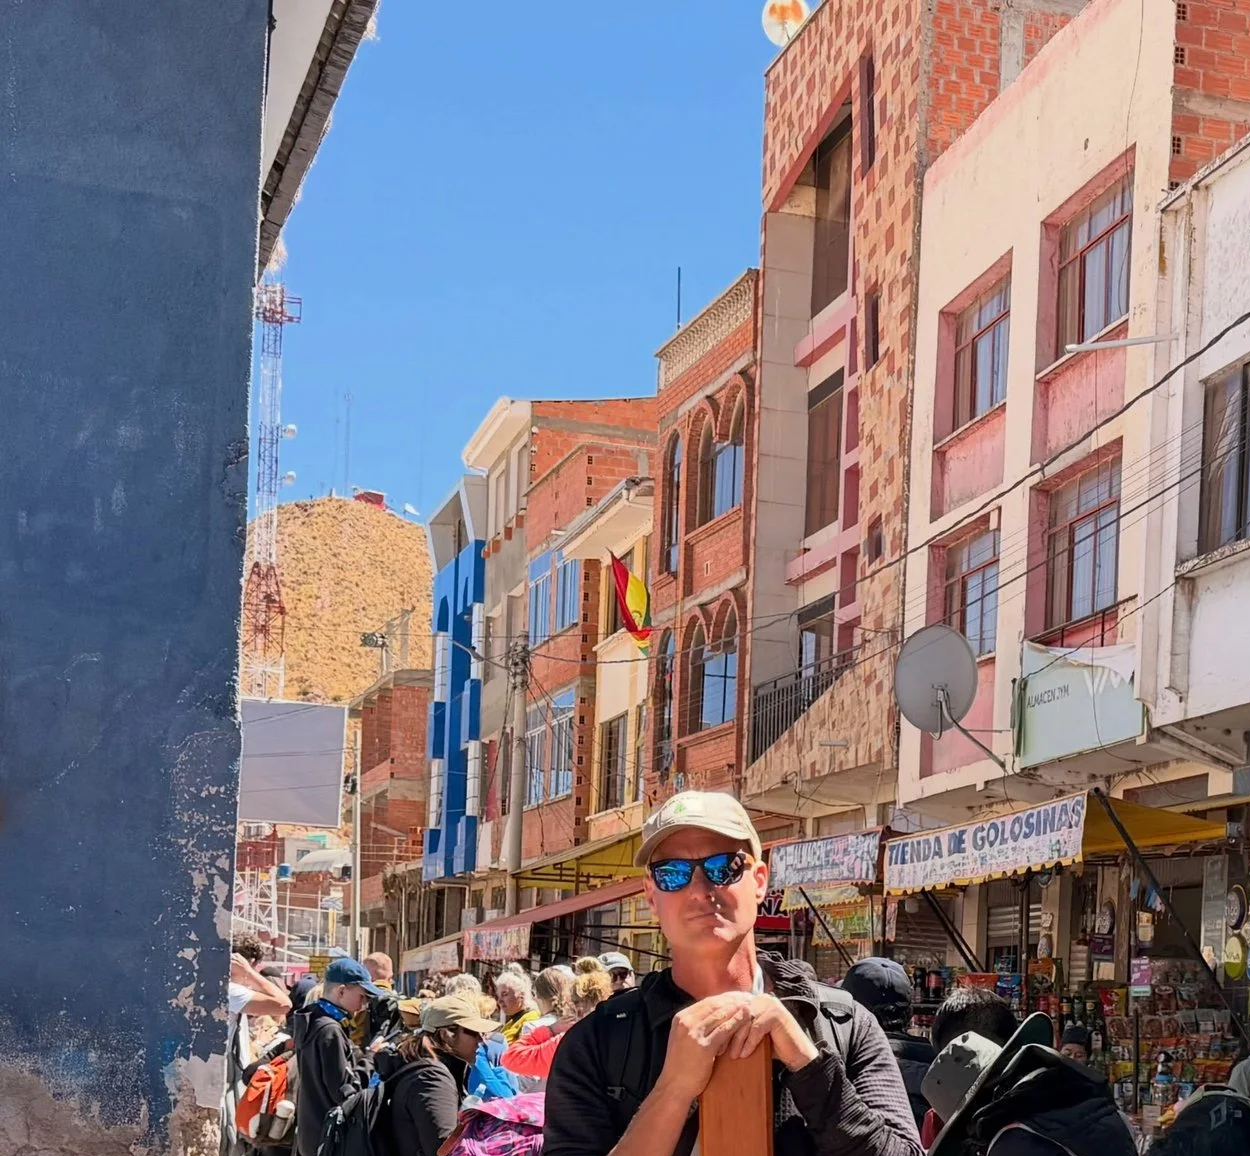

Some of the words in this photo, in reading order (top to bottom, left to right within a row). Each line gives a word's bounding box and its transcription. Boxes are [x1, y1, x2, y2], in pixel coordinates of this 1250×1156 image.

[888, 835, 943, 867] TIENDA
[948, 828, 968, 855] DE
[972, 796, 1085, 852] GOLOSINAS
